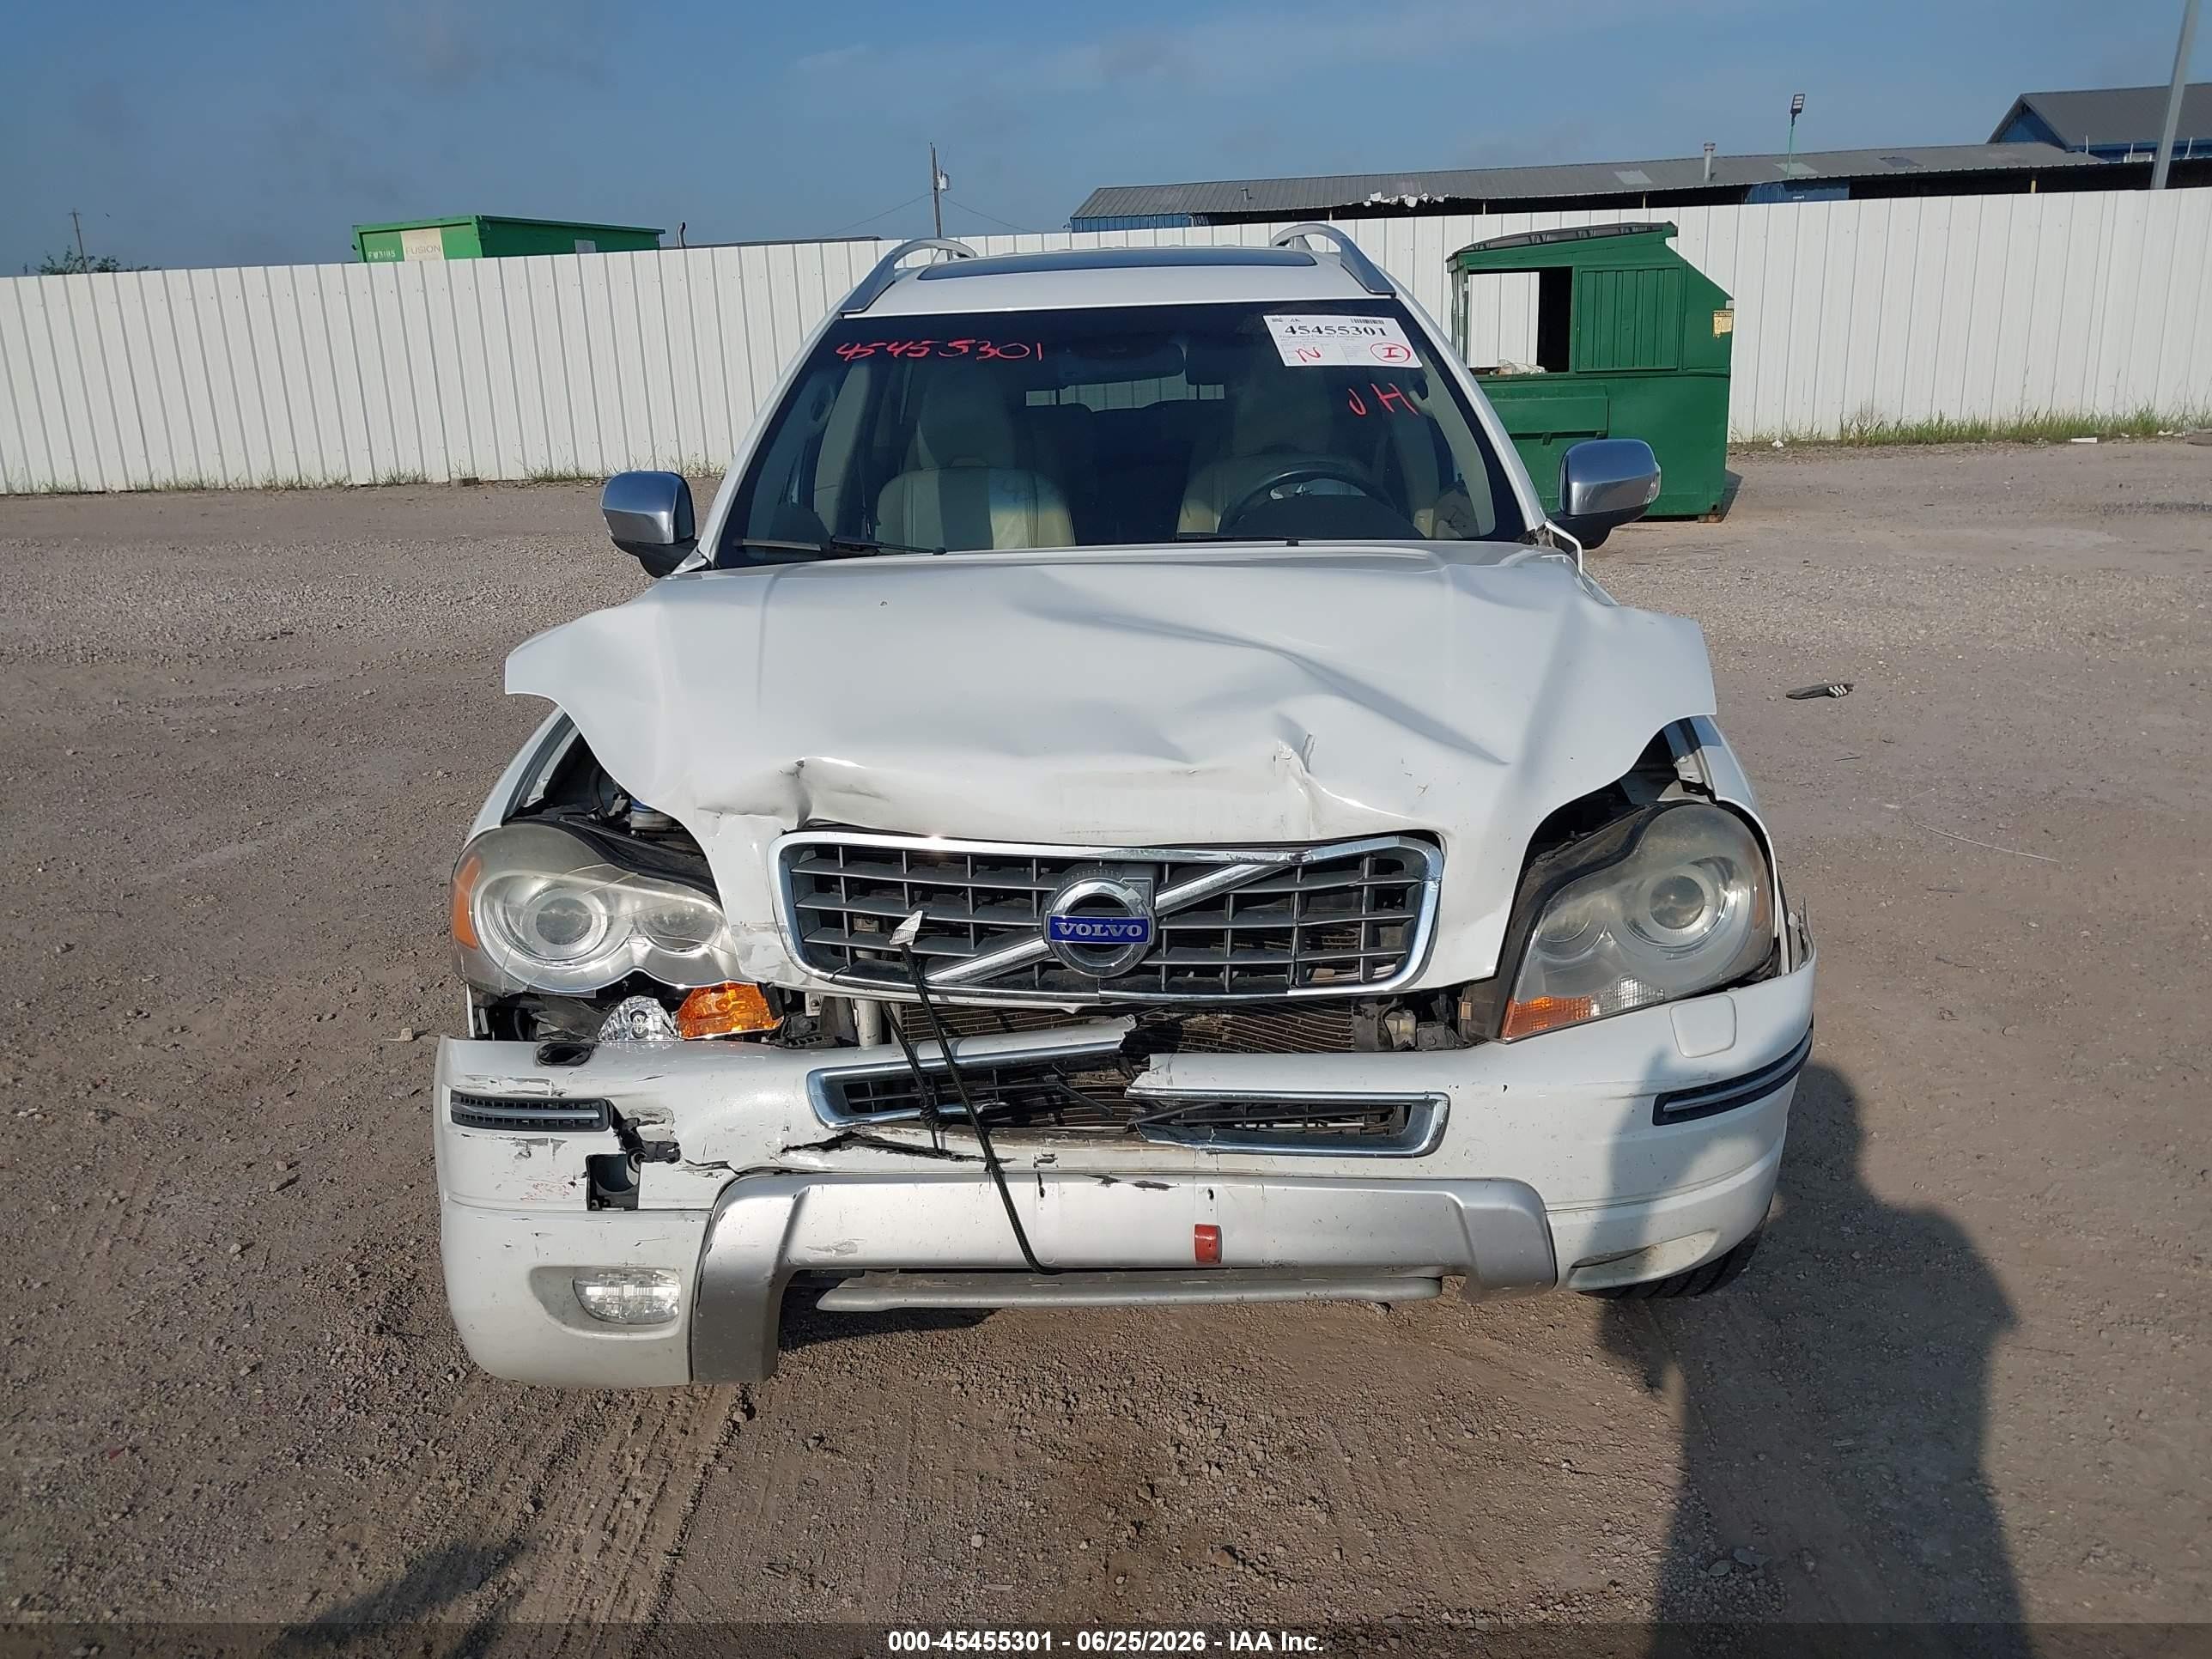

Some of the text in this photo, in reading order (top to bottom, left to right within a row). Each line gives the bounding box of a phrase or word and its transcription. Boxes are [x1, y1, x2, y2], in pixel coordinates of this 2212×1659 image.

[1285, 325, 1388, 337] 45455301
[836, 340, 1042, 361] 45455301
[1054, 922, 1143, 937] VOLVO
